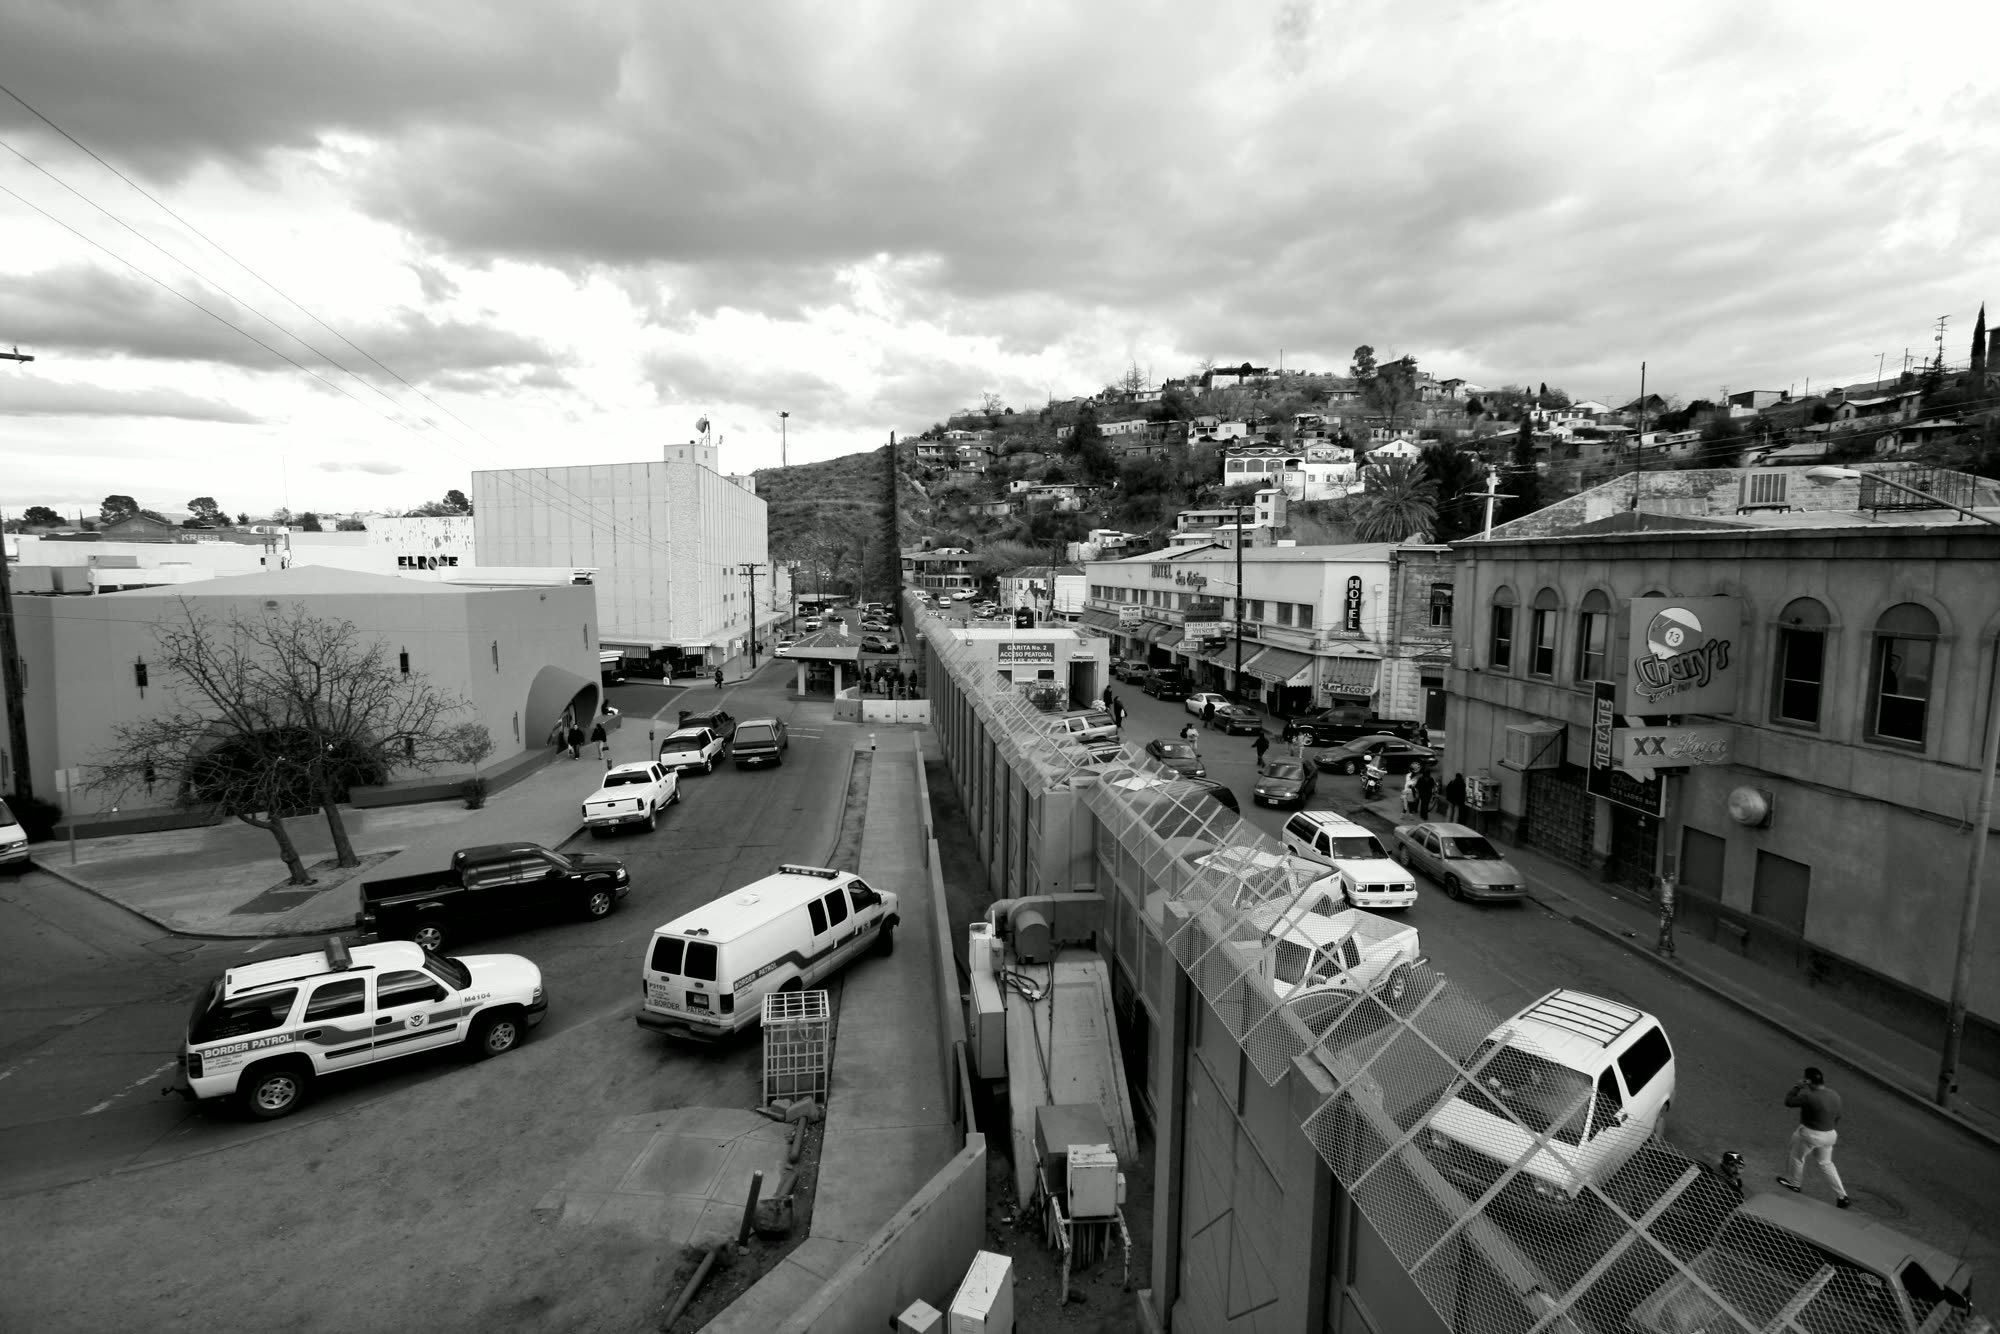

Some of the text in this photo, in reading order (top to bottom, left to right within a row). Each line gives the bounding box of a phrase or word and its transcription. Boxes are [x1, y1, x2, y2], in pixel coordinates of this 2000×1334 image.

[1151, 564, 1173, 579] HOTEL
[1348, 579, 1361, 630] HOTEL
[1668, 631, 1681, 644] 13
[1635, 638, 1731, 688] Cherry's
[1594, 698, 1614, 770] TECATE
[1632, 736, 1668, 756] XX
[734, 961, 777, 990] BORDER PATROL
[464, 992, 491, 1003] M4104
[654, 999, 680, 1010] BORDER
[686, 1006, 711, 1017] PATROL
[204, 1033, 293, 1058] BORDER PATROL
